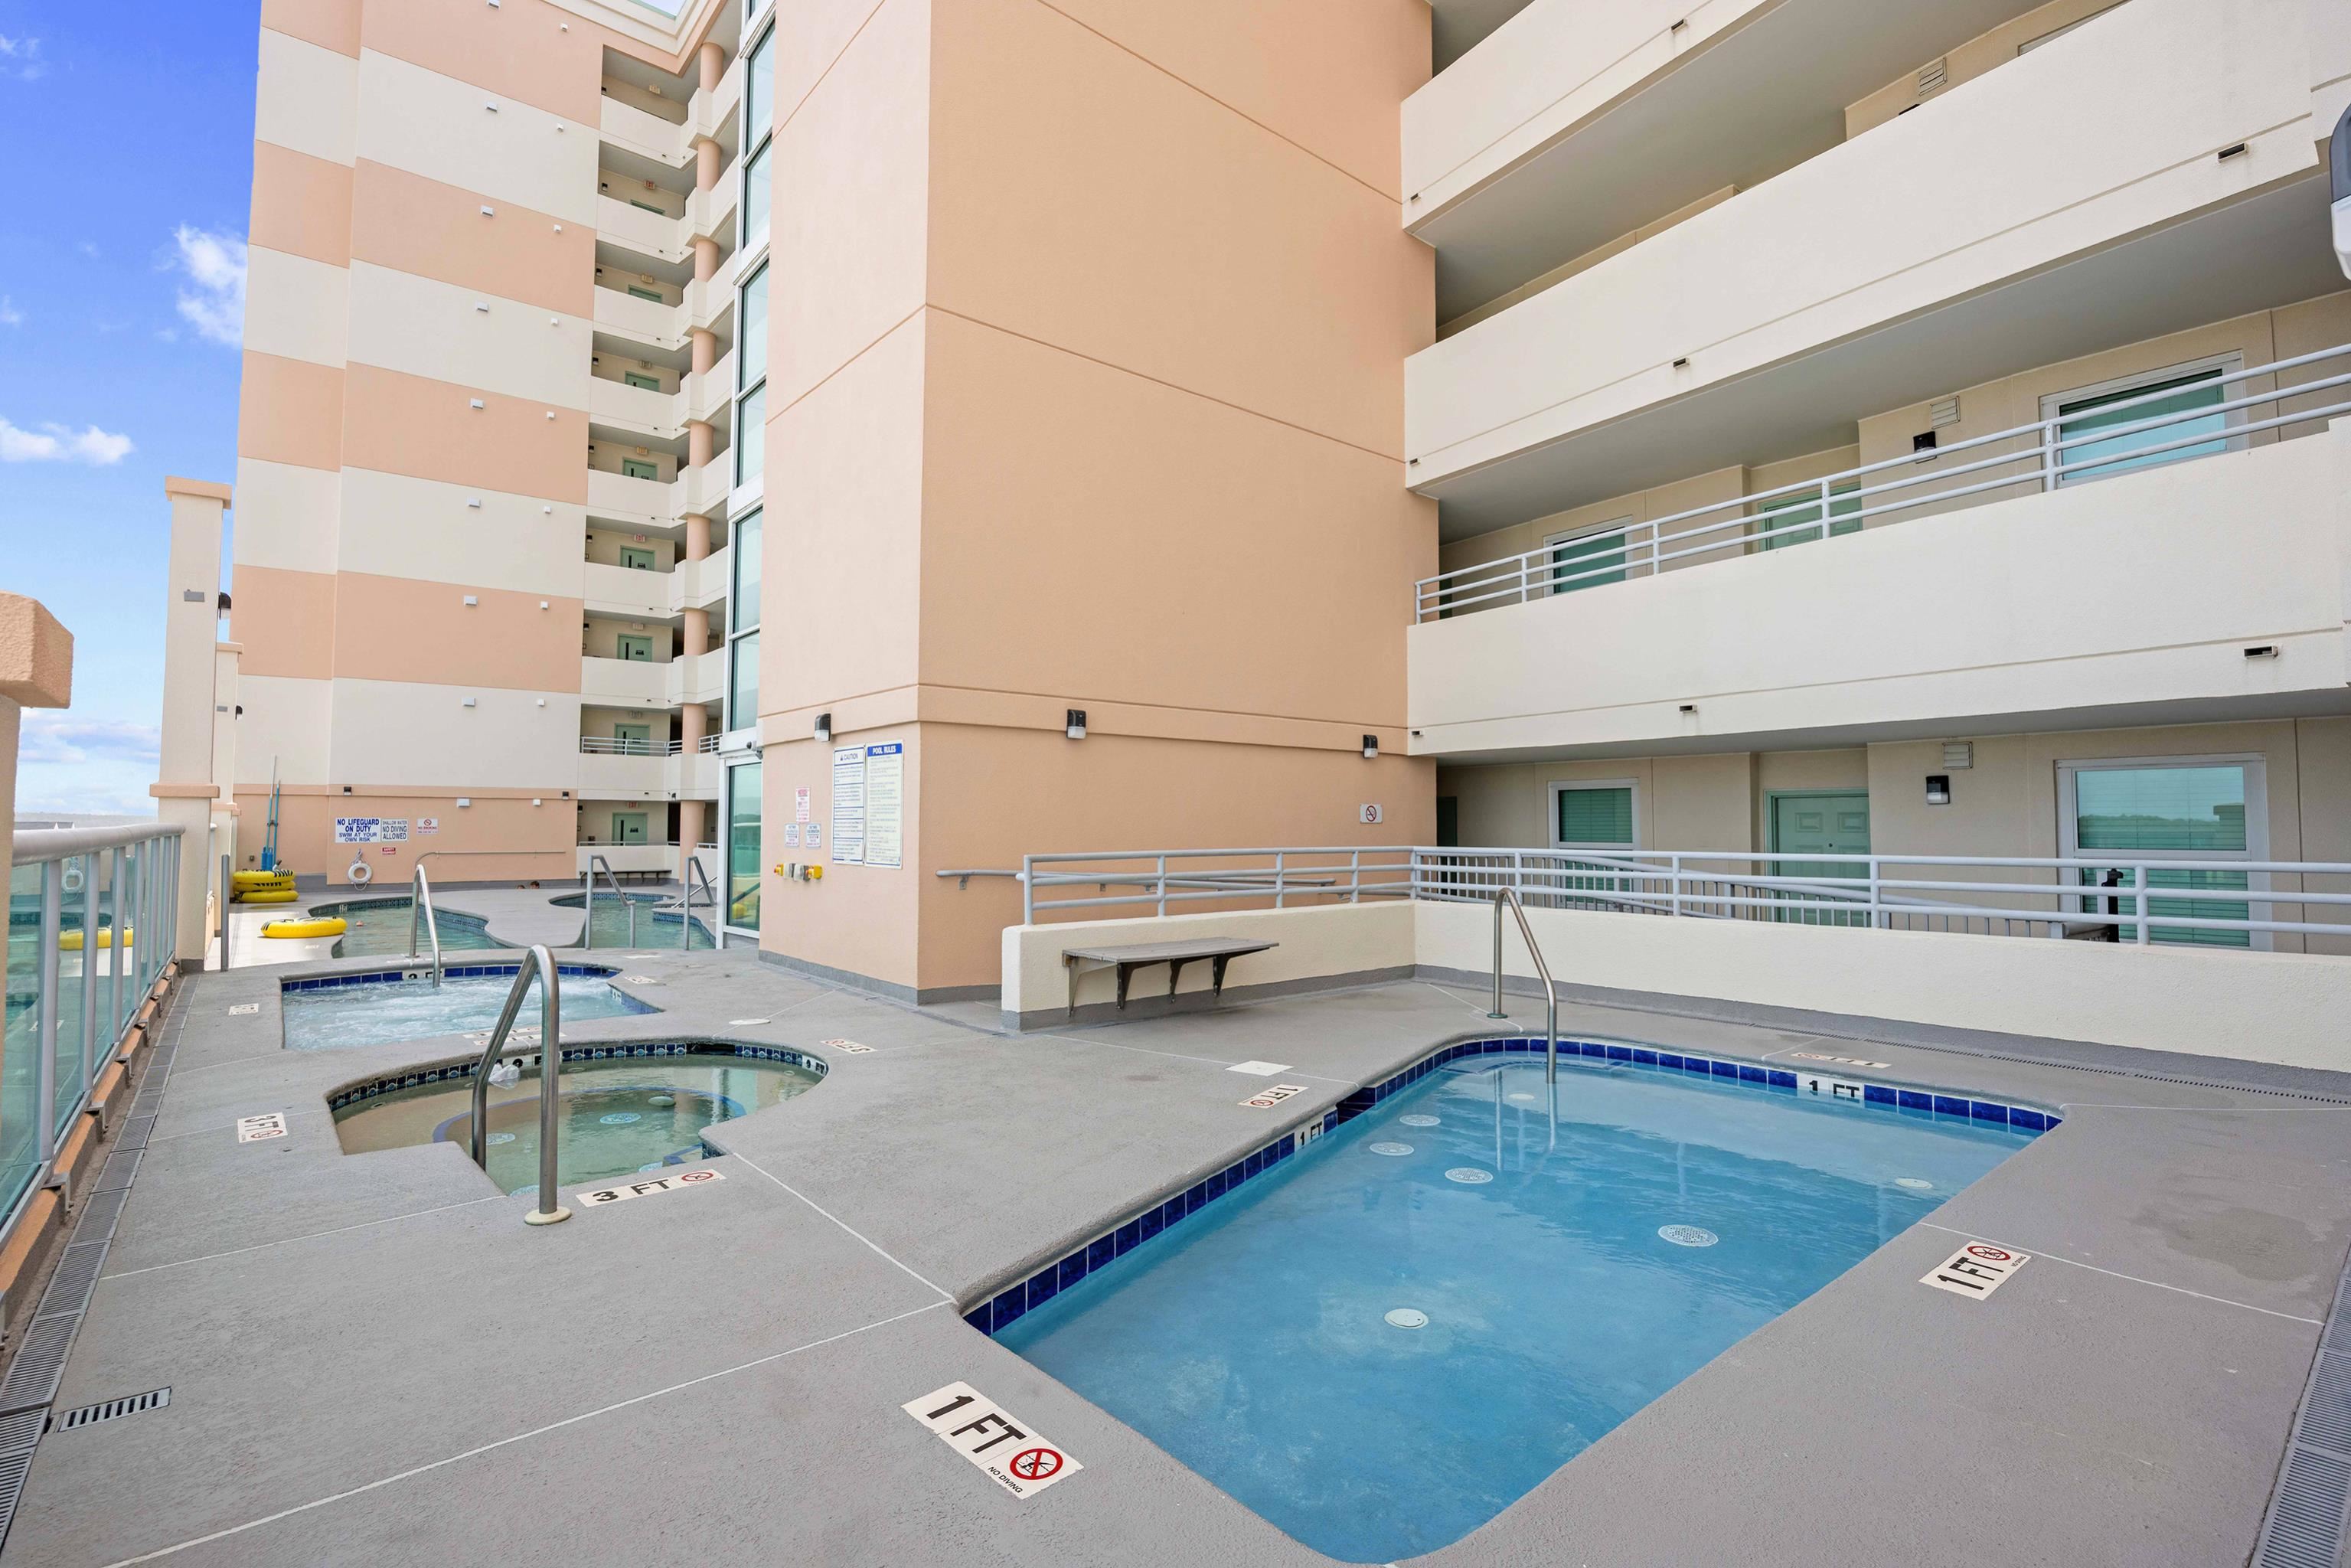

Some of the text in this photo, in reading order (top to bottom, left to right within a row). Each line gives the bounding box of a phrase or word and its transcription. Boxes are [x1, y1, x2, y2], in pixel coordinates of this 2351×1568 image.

[883, 745, 896, 754] RULES
[1809, 1080, 1818, 1092] 1
[1300, 1120, 1323, 1146] 1 FT
[593, 1179, 670, 1202] 3 FT
[1937, 1256, 2004, 1292] 1 FT
[926, 1394, 1027, 1454] 1 FT
[988, 1465, 1024, 1494] NO DIVING
